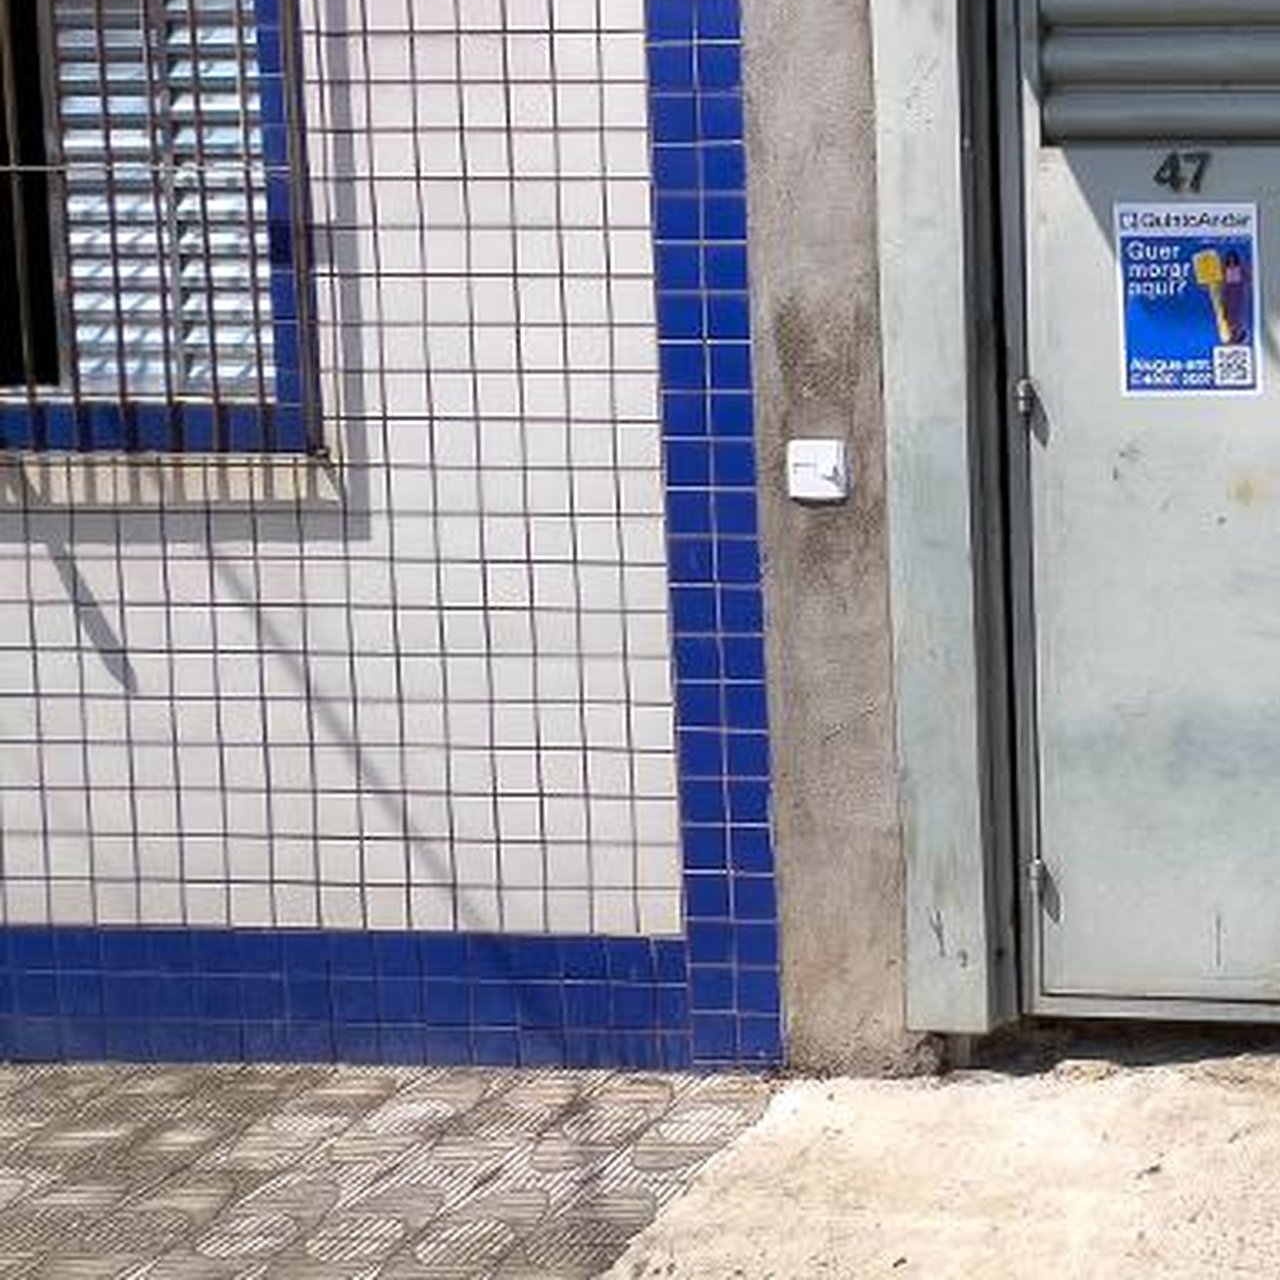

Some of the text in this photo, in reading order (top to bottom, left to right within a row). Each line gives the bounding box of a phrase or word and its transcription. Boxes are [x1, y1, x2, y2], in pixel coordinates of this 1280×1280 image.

[1153, 152, 1211, 192] 47
[1127, 240, 1180, 261] Quer
[1128, 262, 1191, 278] morar
[1128, 279, 1188, 299] aqui?
